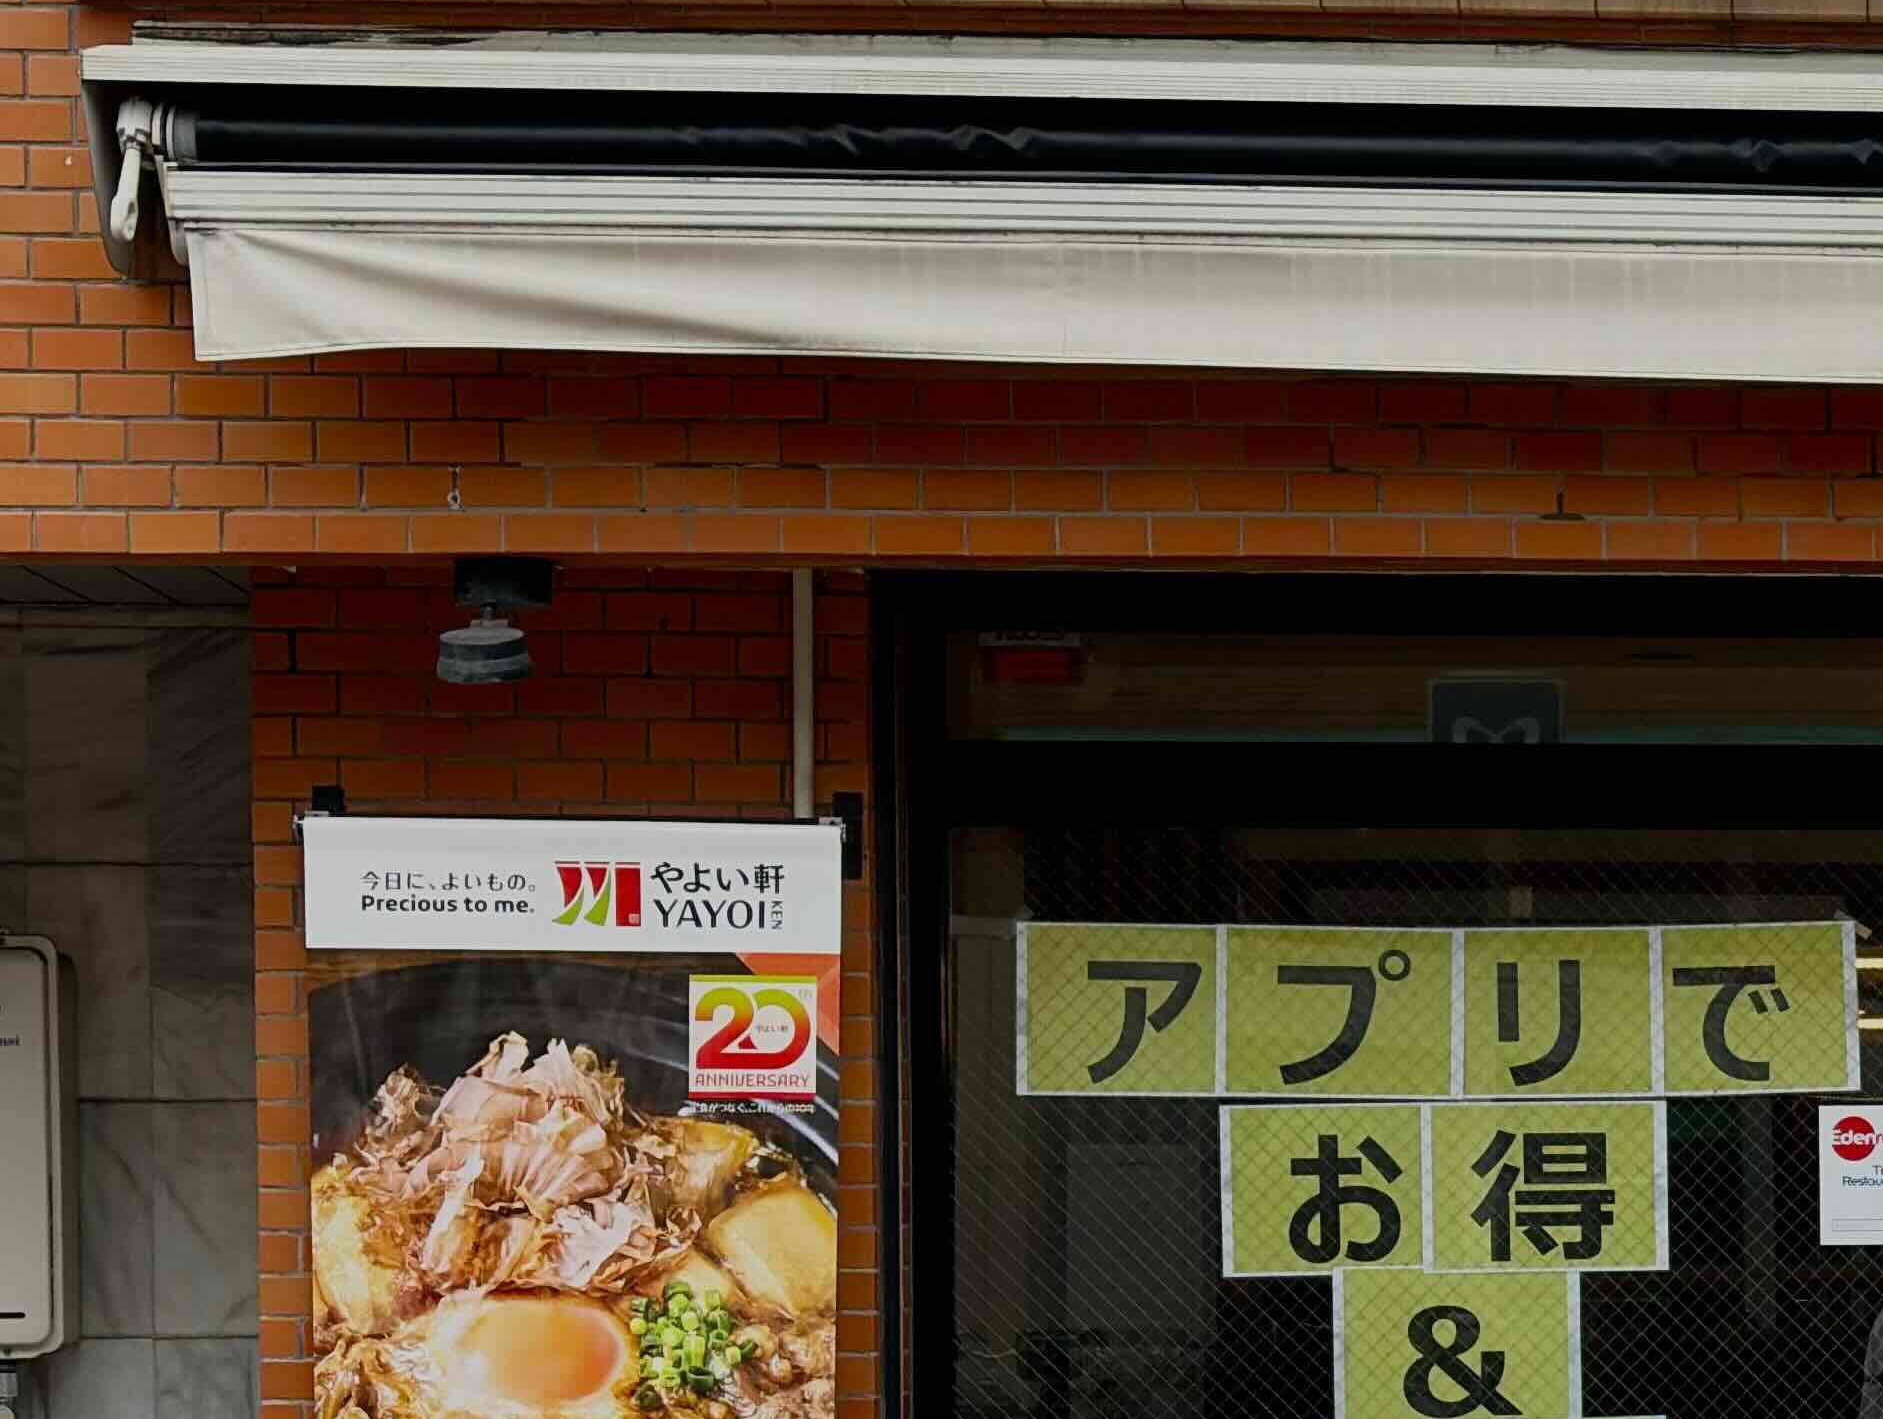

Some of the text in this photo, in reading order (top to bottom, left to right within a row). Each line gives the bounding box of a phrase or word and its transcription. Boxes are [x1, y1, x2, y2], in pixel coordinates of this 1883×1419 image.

[360, 870, 536, 892] 今日に、よいもの。
[650, 861, 786, 894] やよい軒
[361, 894, 535, 913] Precious to me.
[651, 899, 767, 929] YAYOI
[695, 987, 811, 1069] 20
[1085, 949, 1790, 1086] アプリで
[695, 1073, 810, 1087] ANNIVERSARY
[1287, 1129, 1616, 1264] お得
[1402, 1304, 1521, 1419] &
